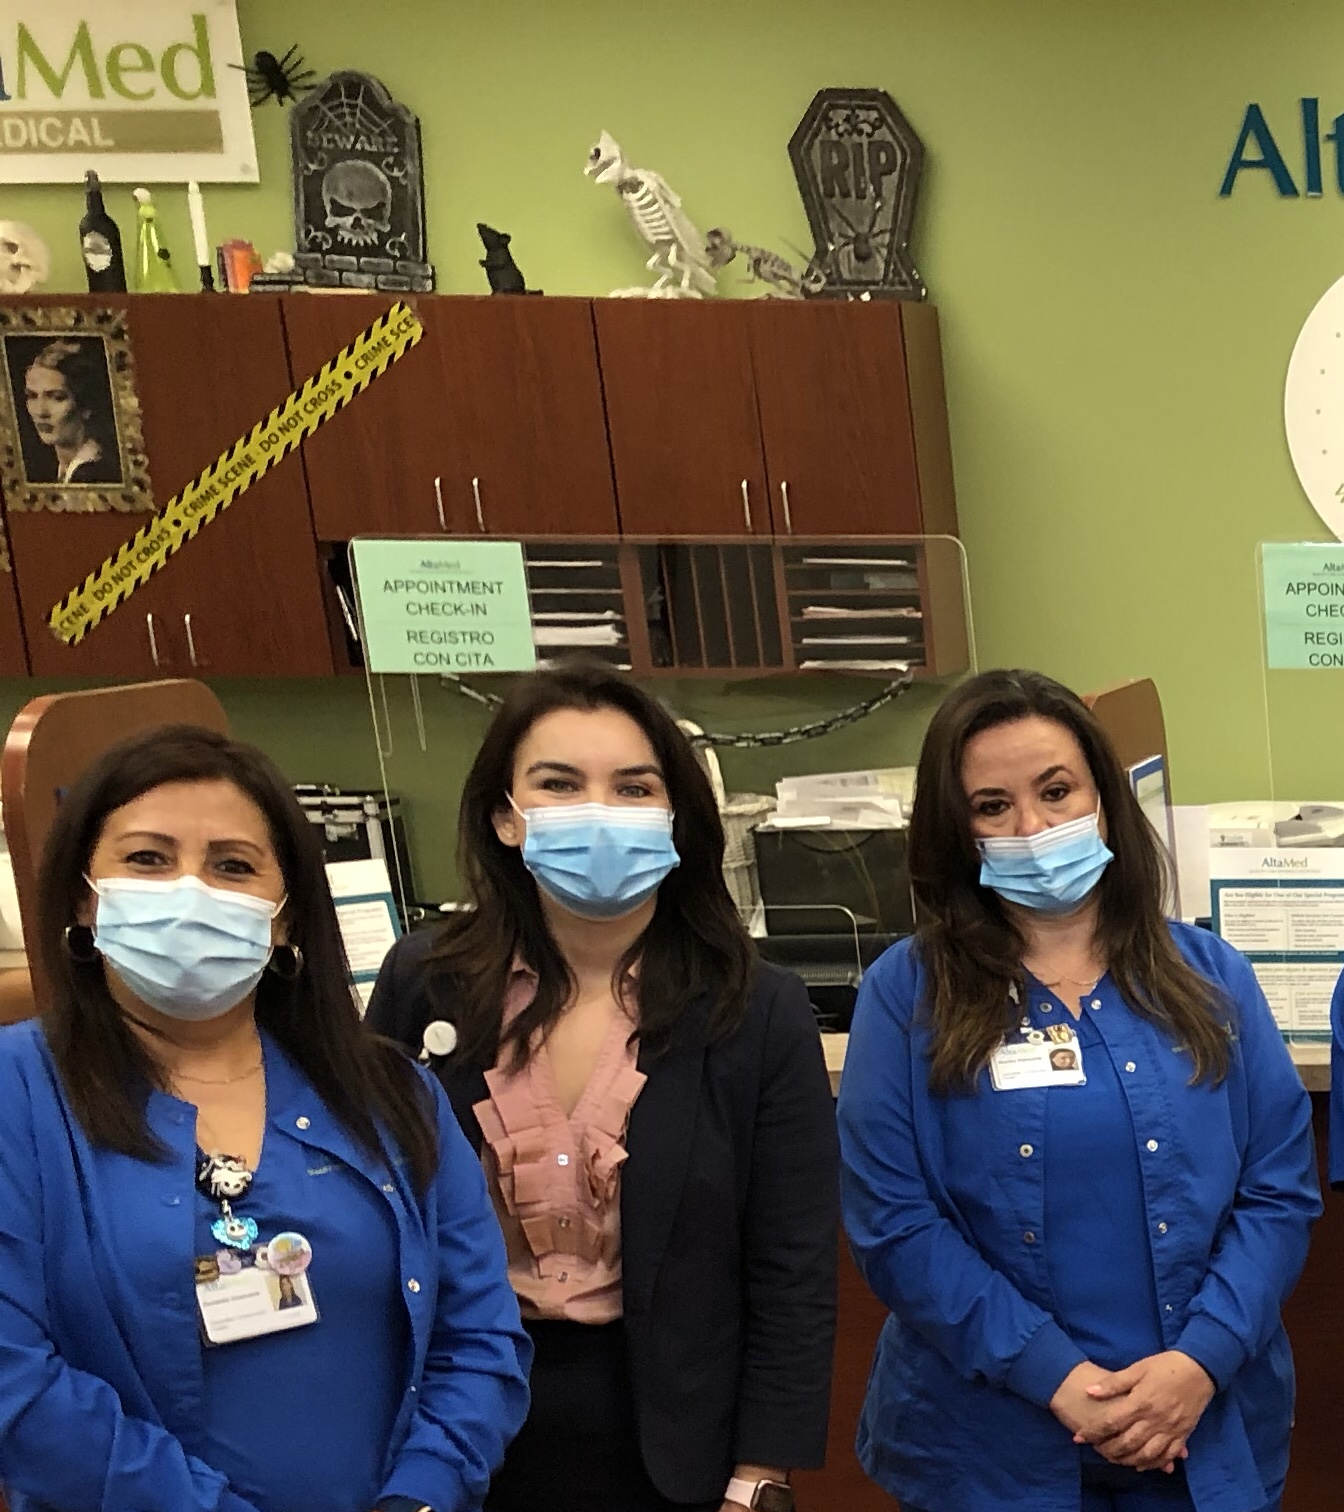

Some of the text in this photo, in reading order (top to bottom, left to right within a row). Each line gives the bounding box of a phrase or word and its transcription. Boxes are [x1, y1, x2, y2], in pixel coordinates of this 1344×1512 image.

[0, 117, 115, 148] DICAL
[820, 140, 898, 200] RIP
[354, 335, 393, 371] CRIME
[183, 378, 343, 519] CRIME SCENE DO NOT CROSS
[92, 580, 114, 602] DO
[112, 560, 138, 584] NOT
[135, 528, 172, 564] CROSS
[383, 580, 503, 595] APPOINTMENT
[406, 602, 487, 616] CHECK-IN
[406, 630, 494, 645] REGISTRO
[414, 652, 494, 667] CON CITA
[1308, 653, 1344, 667] CON
[1261, 857, 1308, 868] AltaMed
